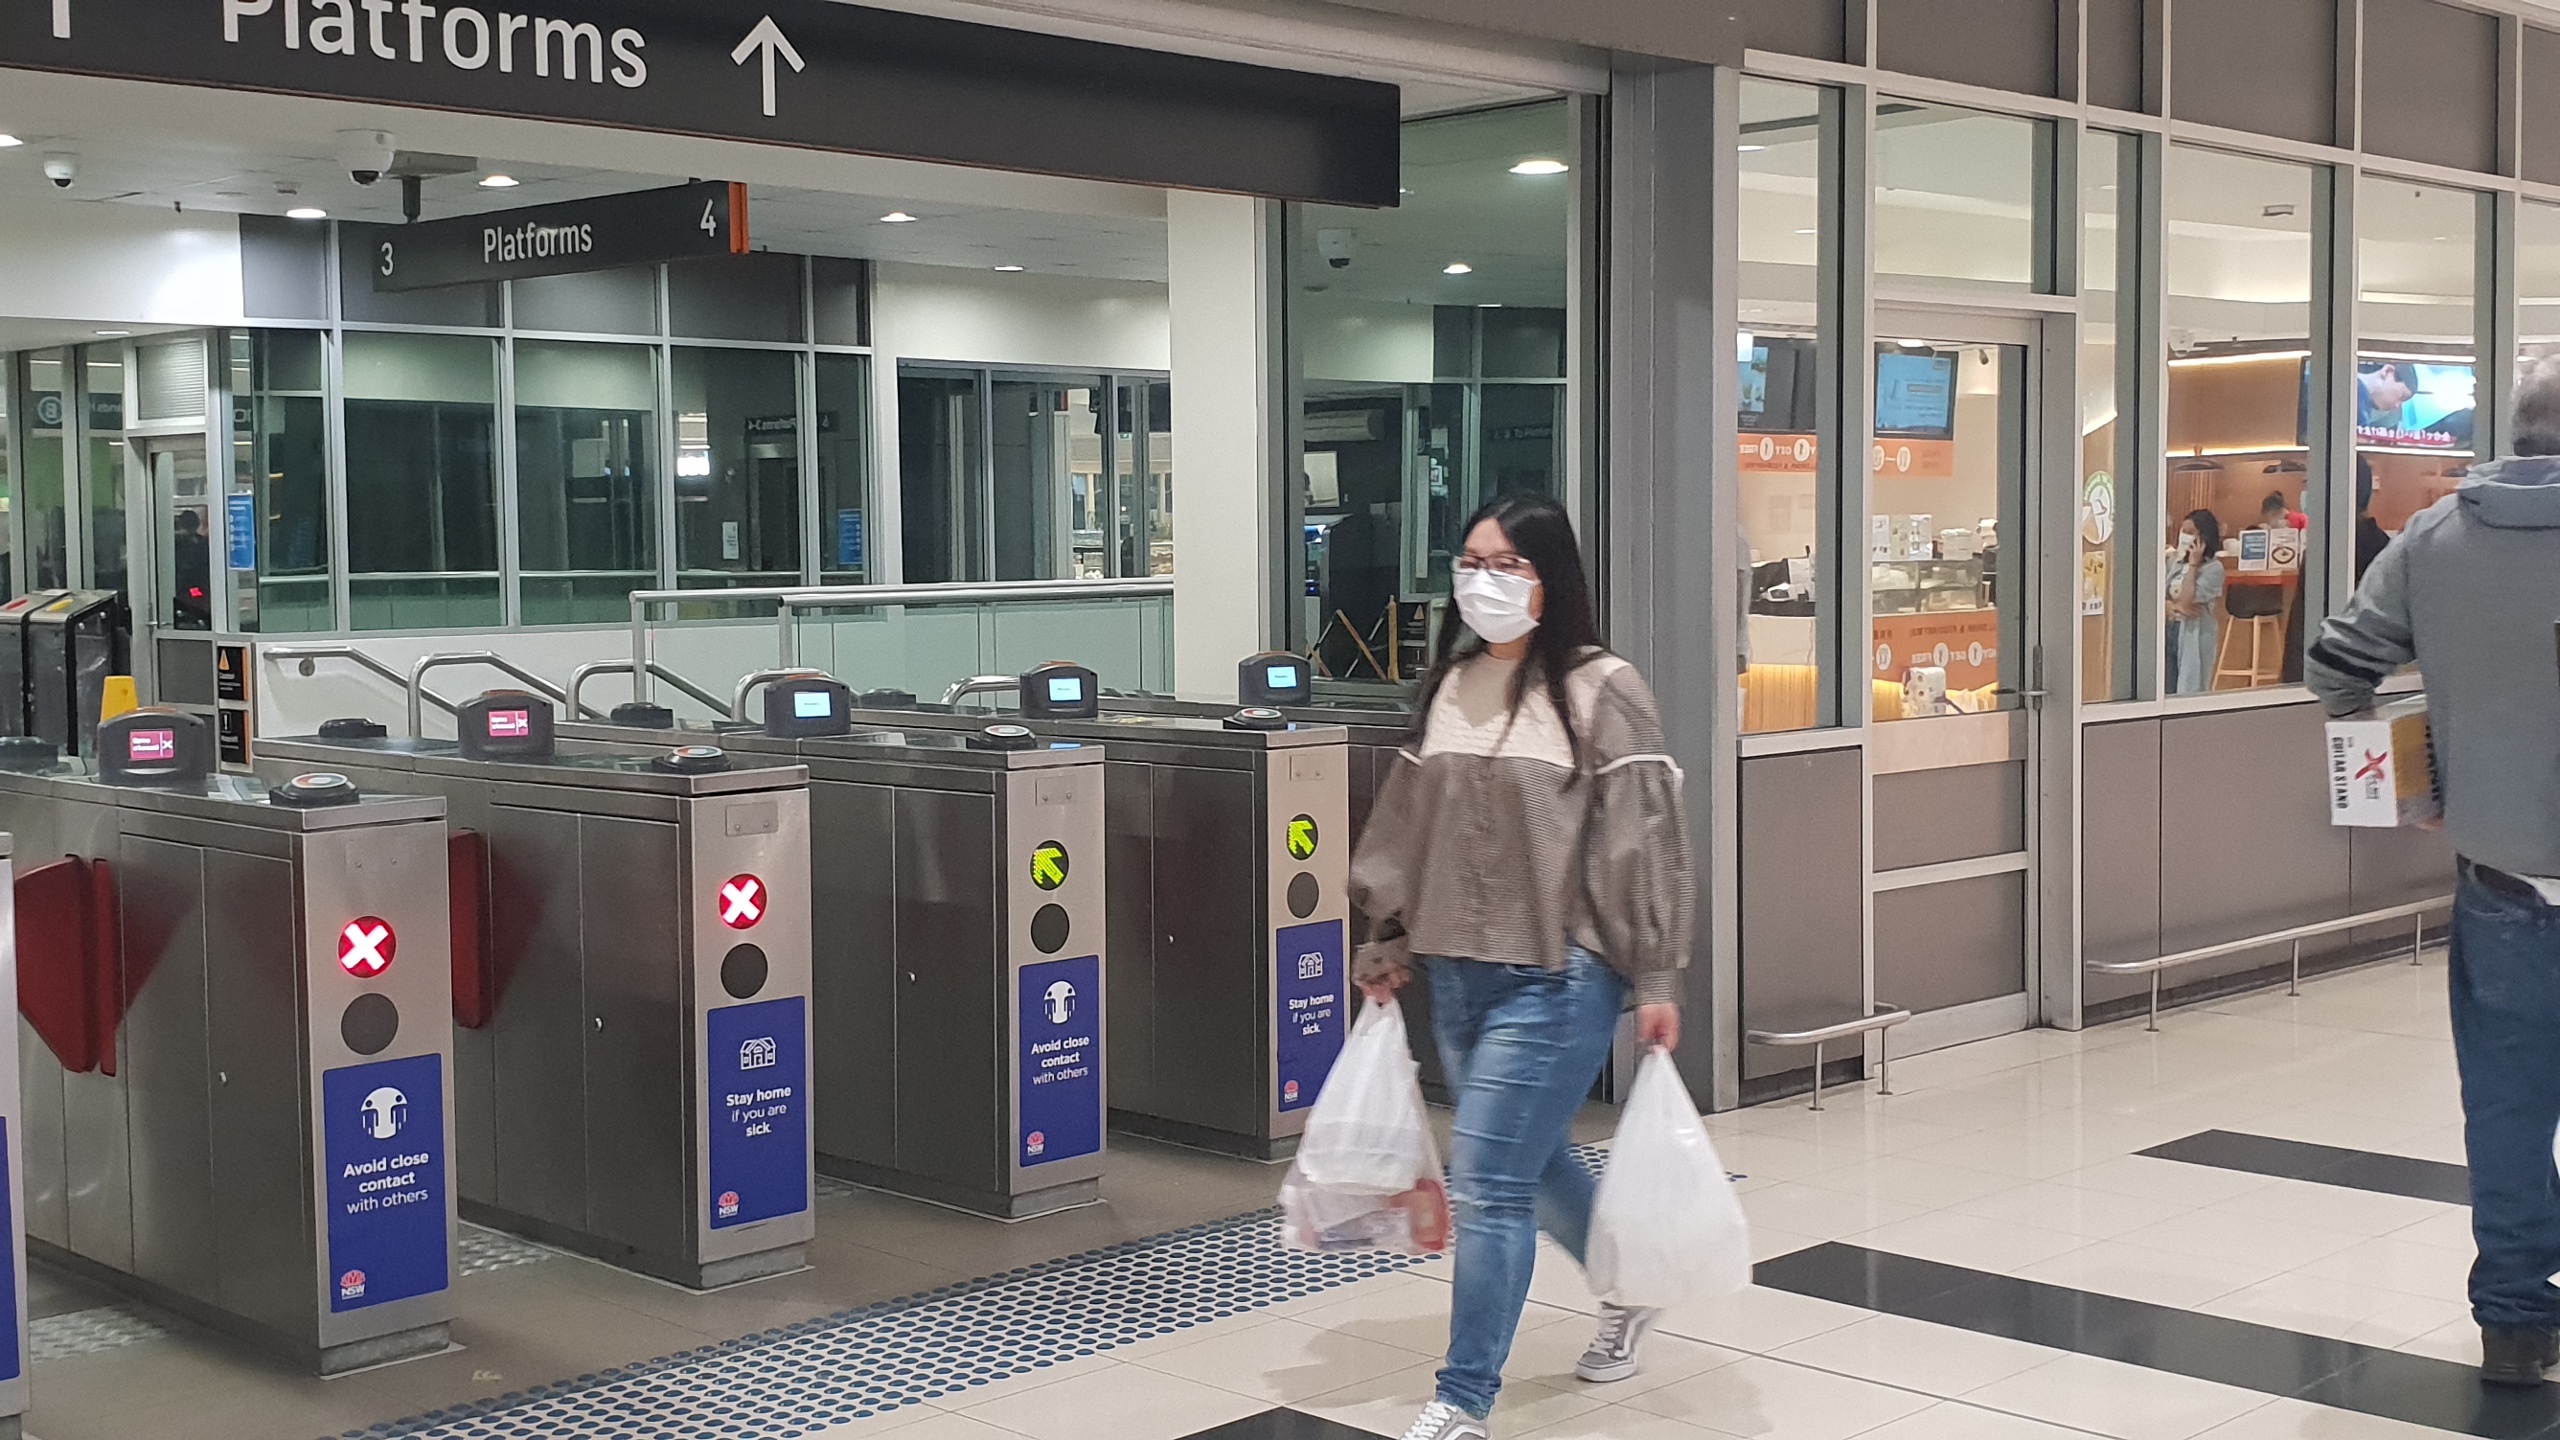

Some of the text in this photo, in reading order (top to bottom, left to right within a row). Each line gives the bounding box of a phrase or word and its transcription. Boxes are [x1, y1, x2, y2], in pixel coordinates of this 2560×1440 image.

[222, 0, 648, 89] Platforms
[380, 199, 717, 276] 3 Platforms 4
[1289, 993, 1334, 1010] Stay home
[1292, 1008, 1331, 1024] if you are
[1031, 1035, 1090, 1055] Avoid close
[1041, 1051, 1080, 1068] contact
[1033, 1066, 1089, 1085] with others
[726, 1085, 792, 1107] Stay home
[731, 1104, 787, 1124] if you are
[745, 1122, 772, 1137] sick.
[343, 1152, 429, 1178] Avoid close
[358, 1171, 416, 1193] contact
[346, 1189, 428, 1214] with others
[719, 1204, 739, 1216] NSW
[341, 1284, 365, 1297] NSW
